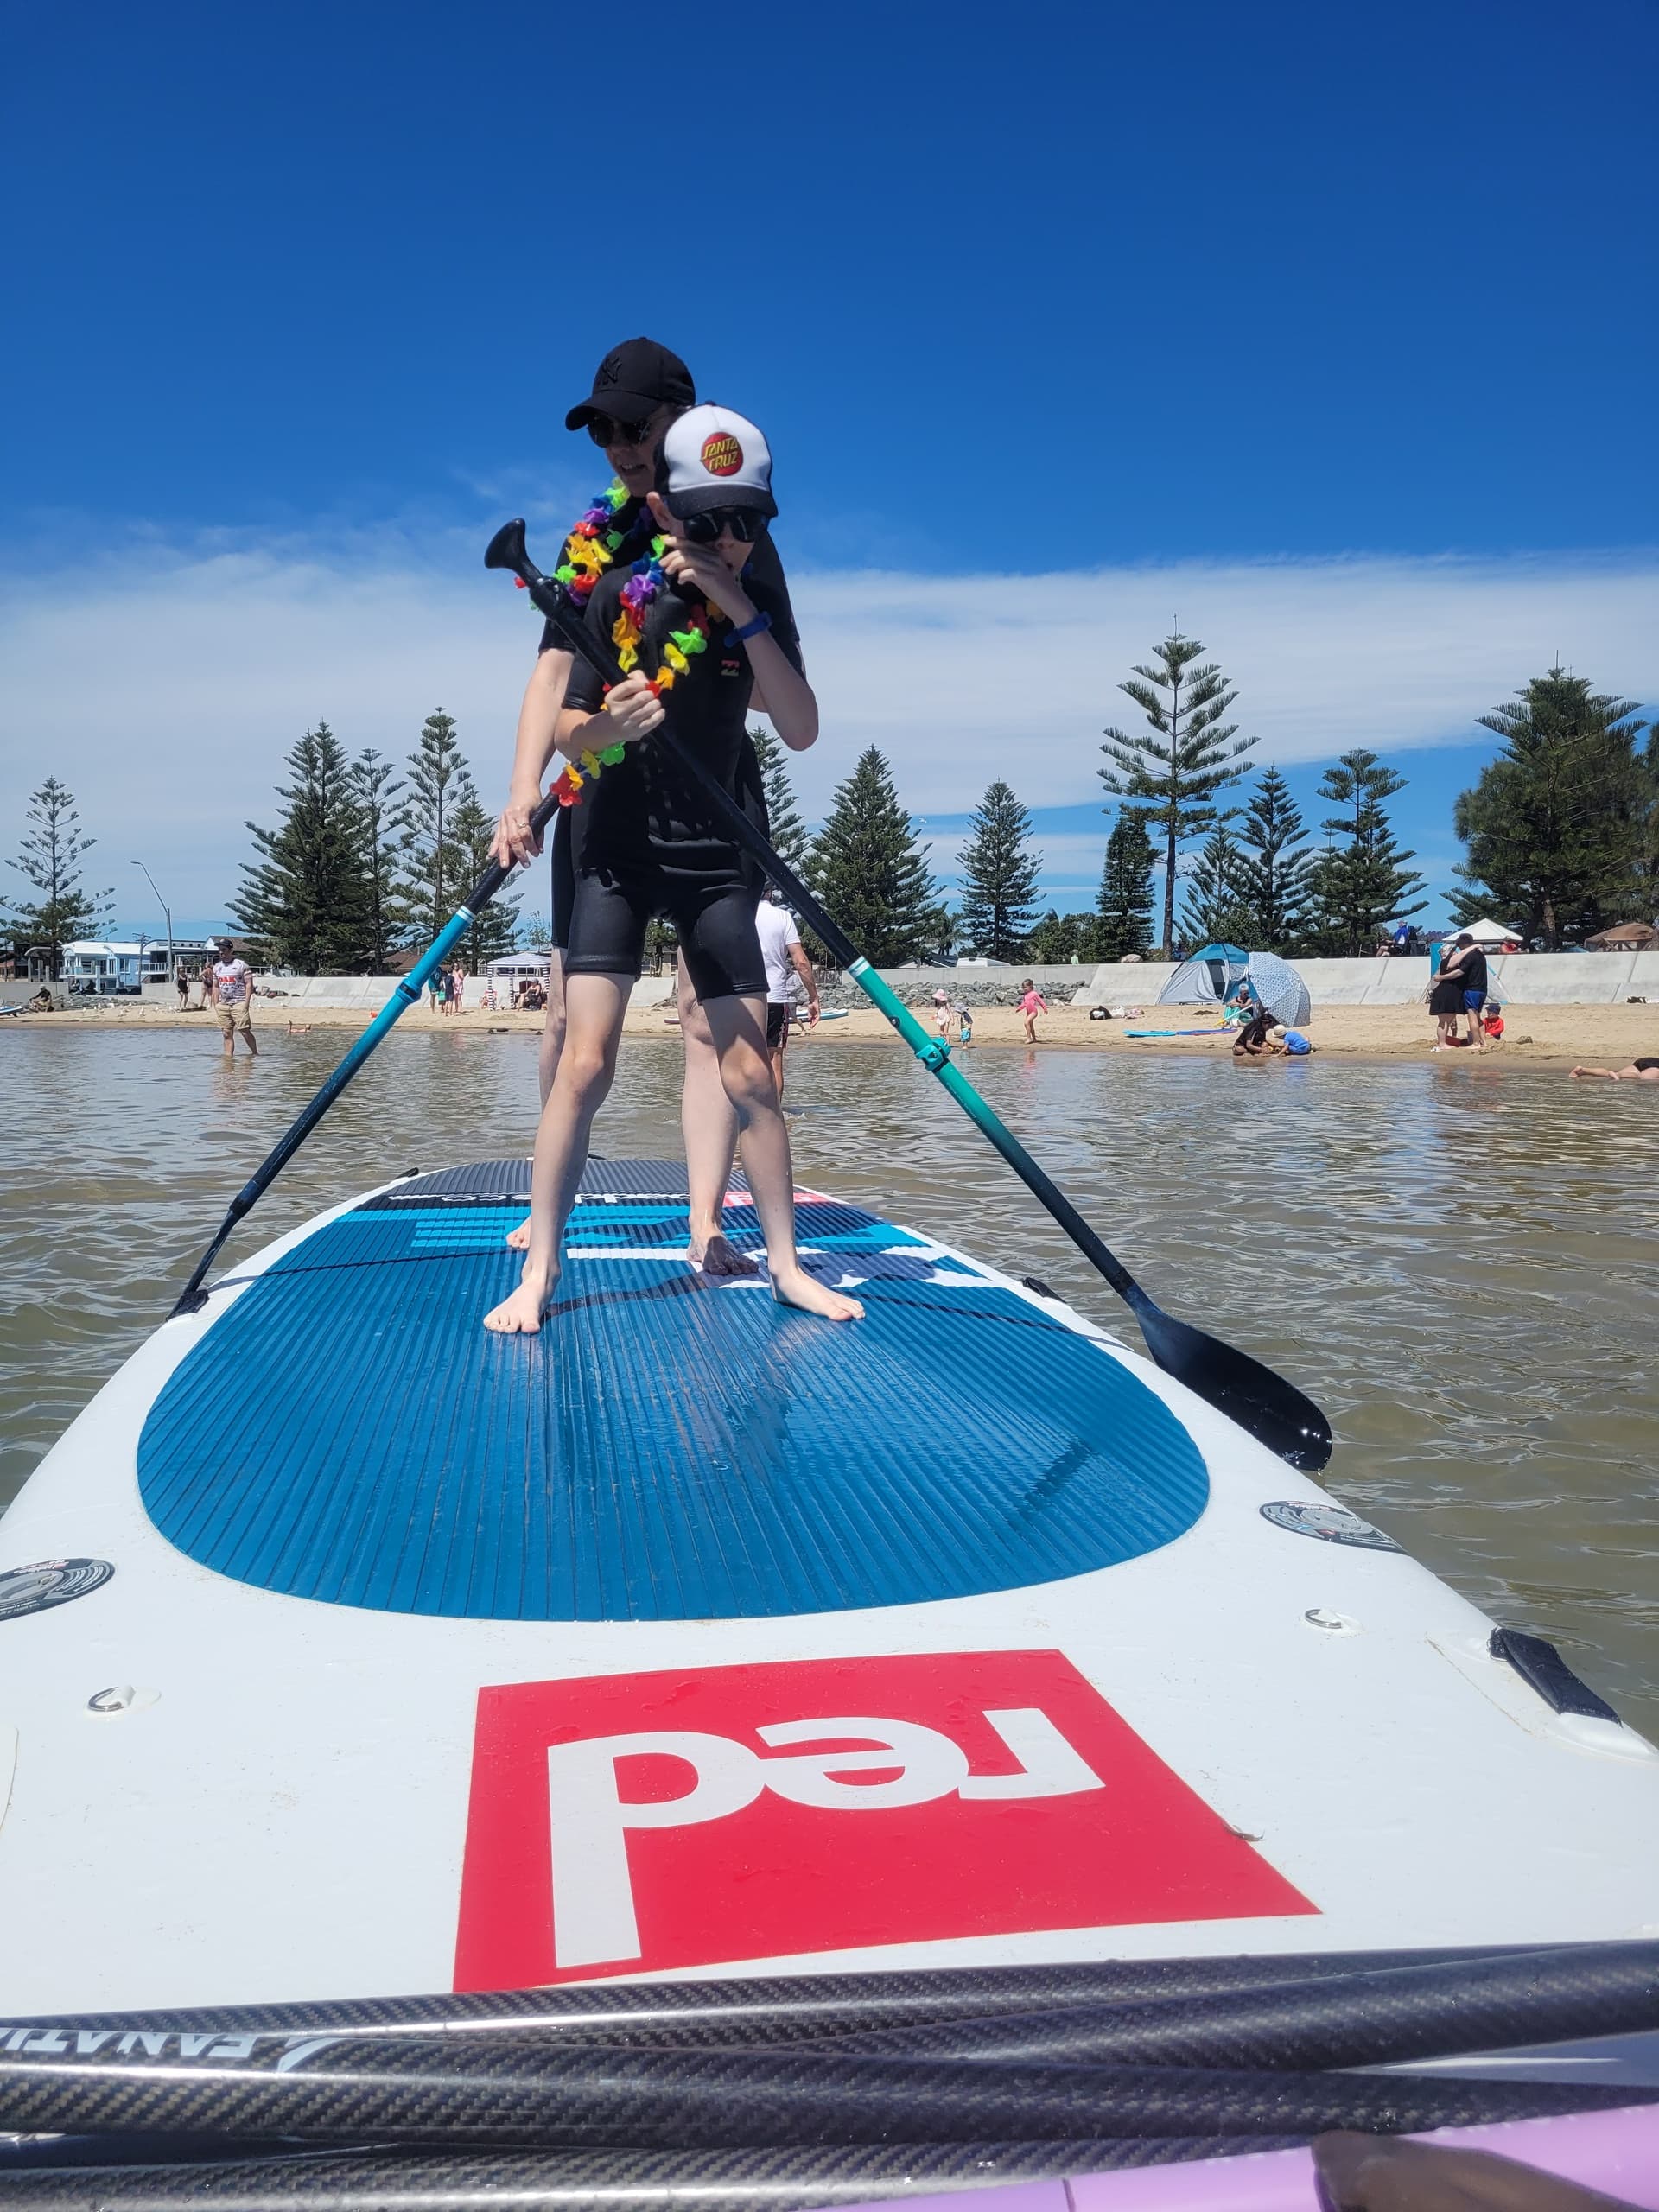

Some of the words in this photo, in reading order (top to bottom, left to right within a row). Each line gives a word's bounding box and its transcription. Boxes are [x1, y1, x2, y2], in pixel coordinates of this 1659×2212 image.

[702, 437, 739, 460] SANTA
[709, 451, 739, 471] CRUZ
[547, 1707, 1105, 1968] red
[0, 2028, 257, 2058] FANATI
